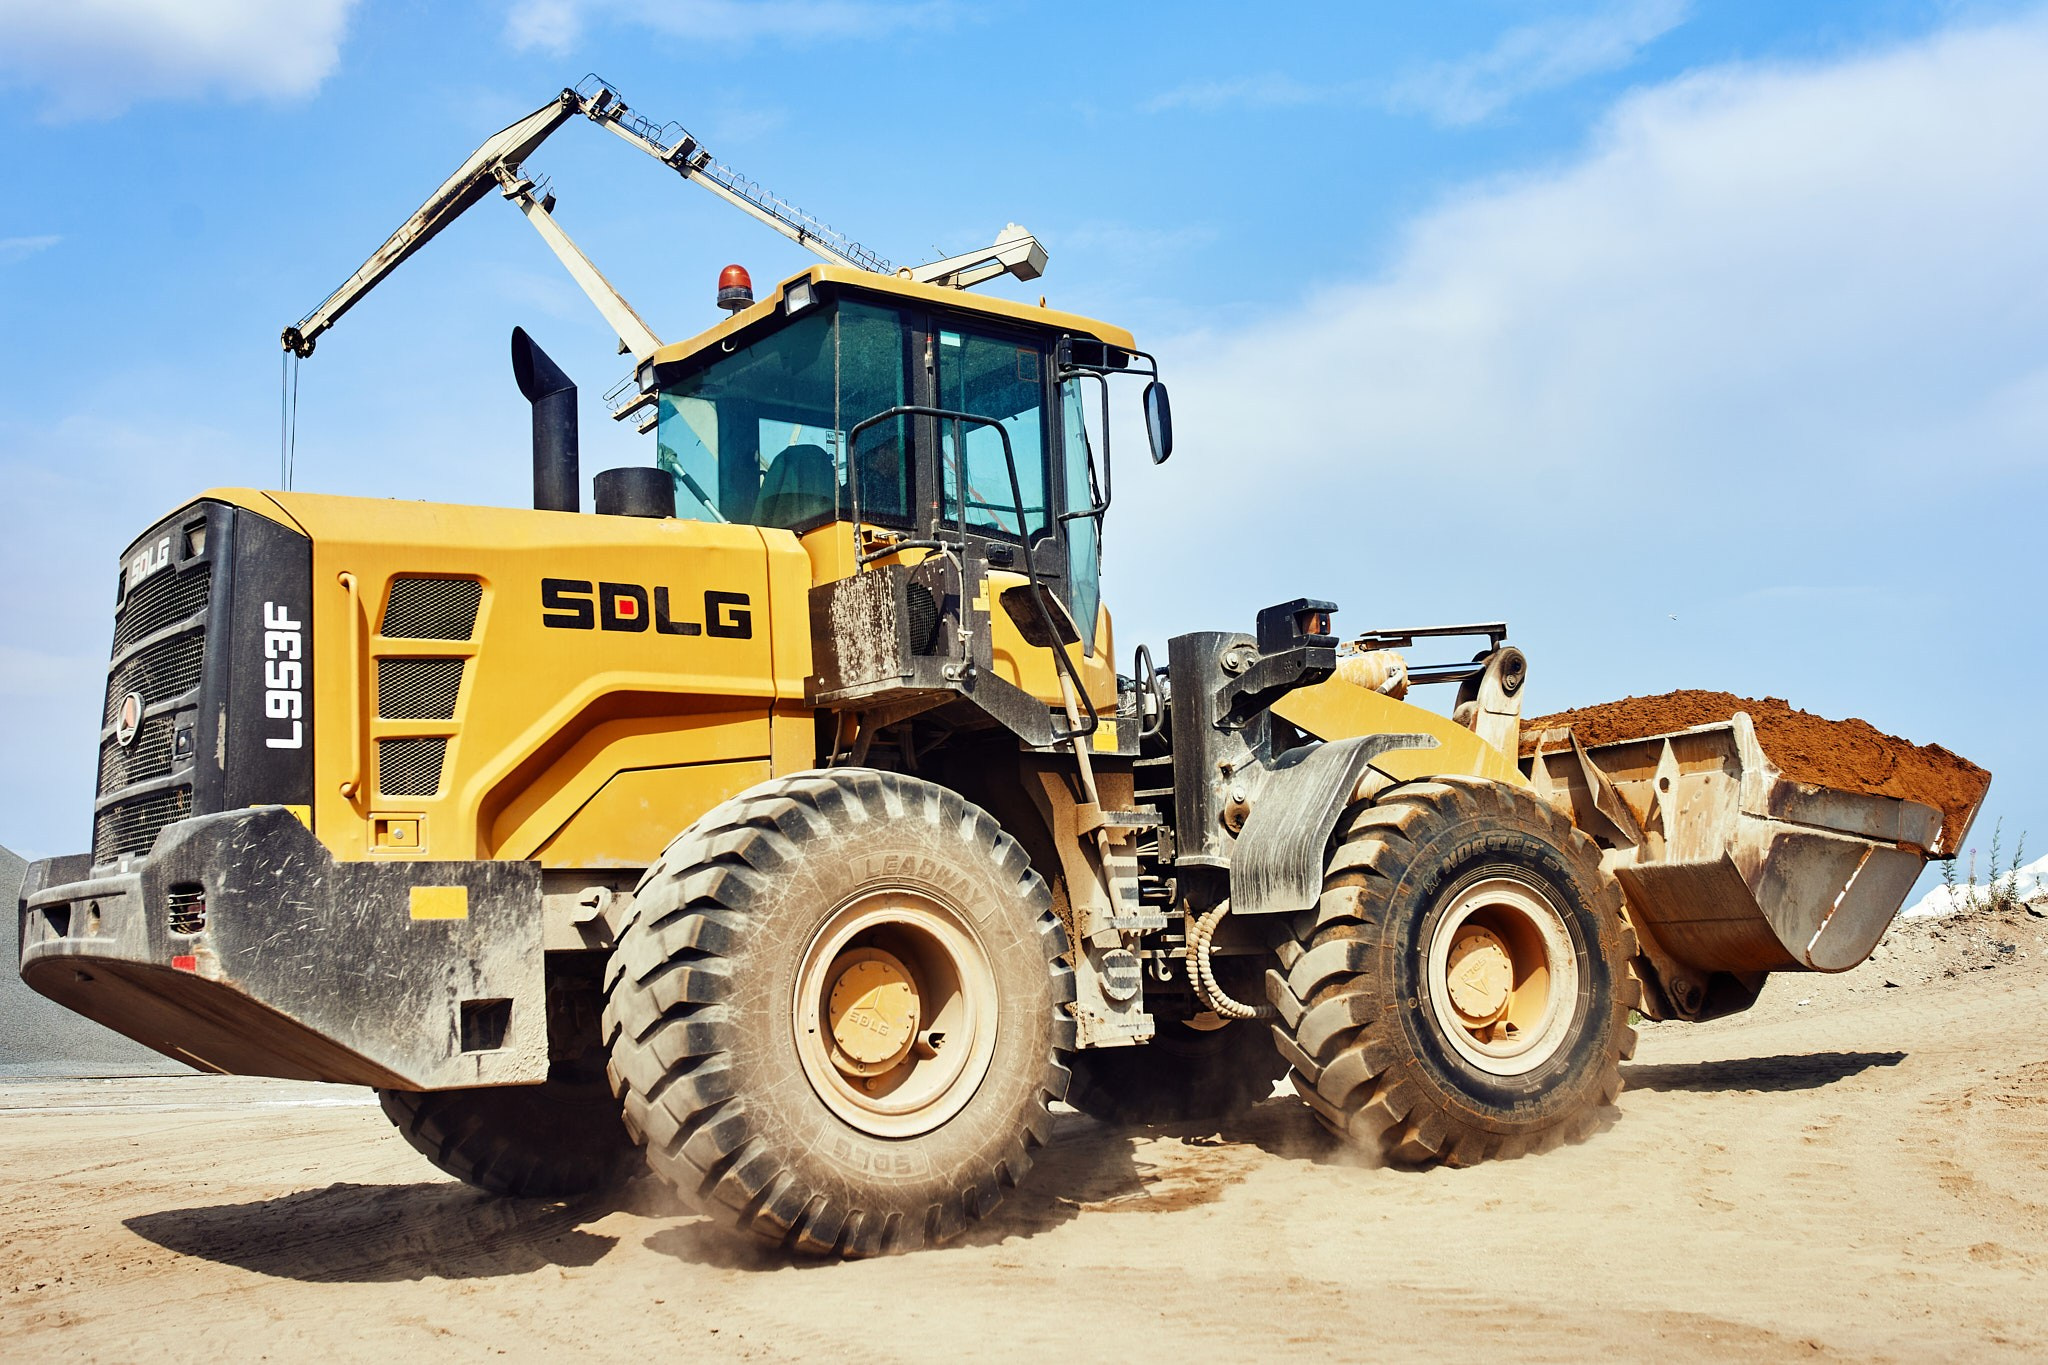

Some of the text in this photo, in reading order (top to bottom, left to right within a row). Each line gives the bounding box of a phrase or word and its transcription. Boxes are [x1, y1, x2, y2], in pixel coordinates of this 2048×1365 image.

[131, 537, 170, 587] SDLG
[541, 578, 753, 640] SDLG
[264, 602, 302, 749] L953F
[1443, 836, 1538, 874] NORTEC
[864, 855, 988, 909] LEADWAY
[849, 1011, 889, 1037] SDLG
[832, 1136, 913, 1175] SDLG
